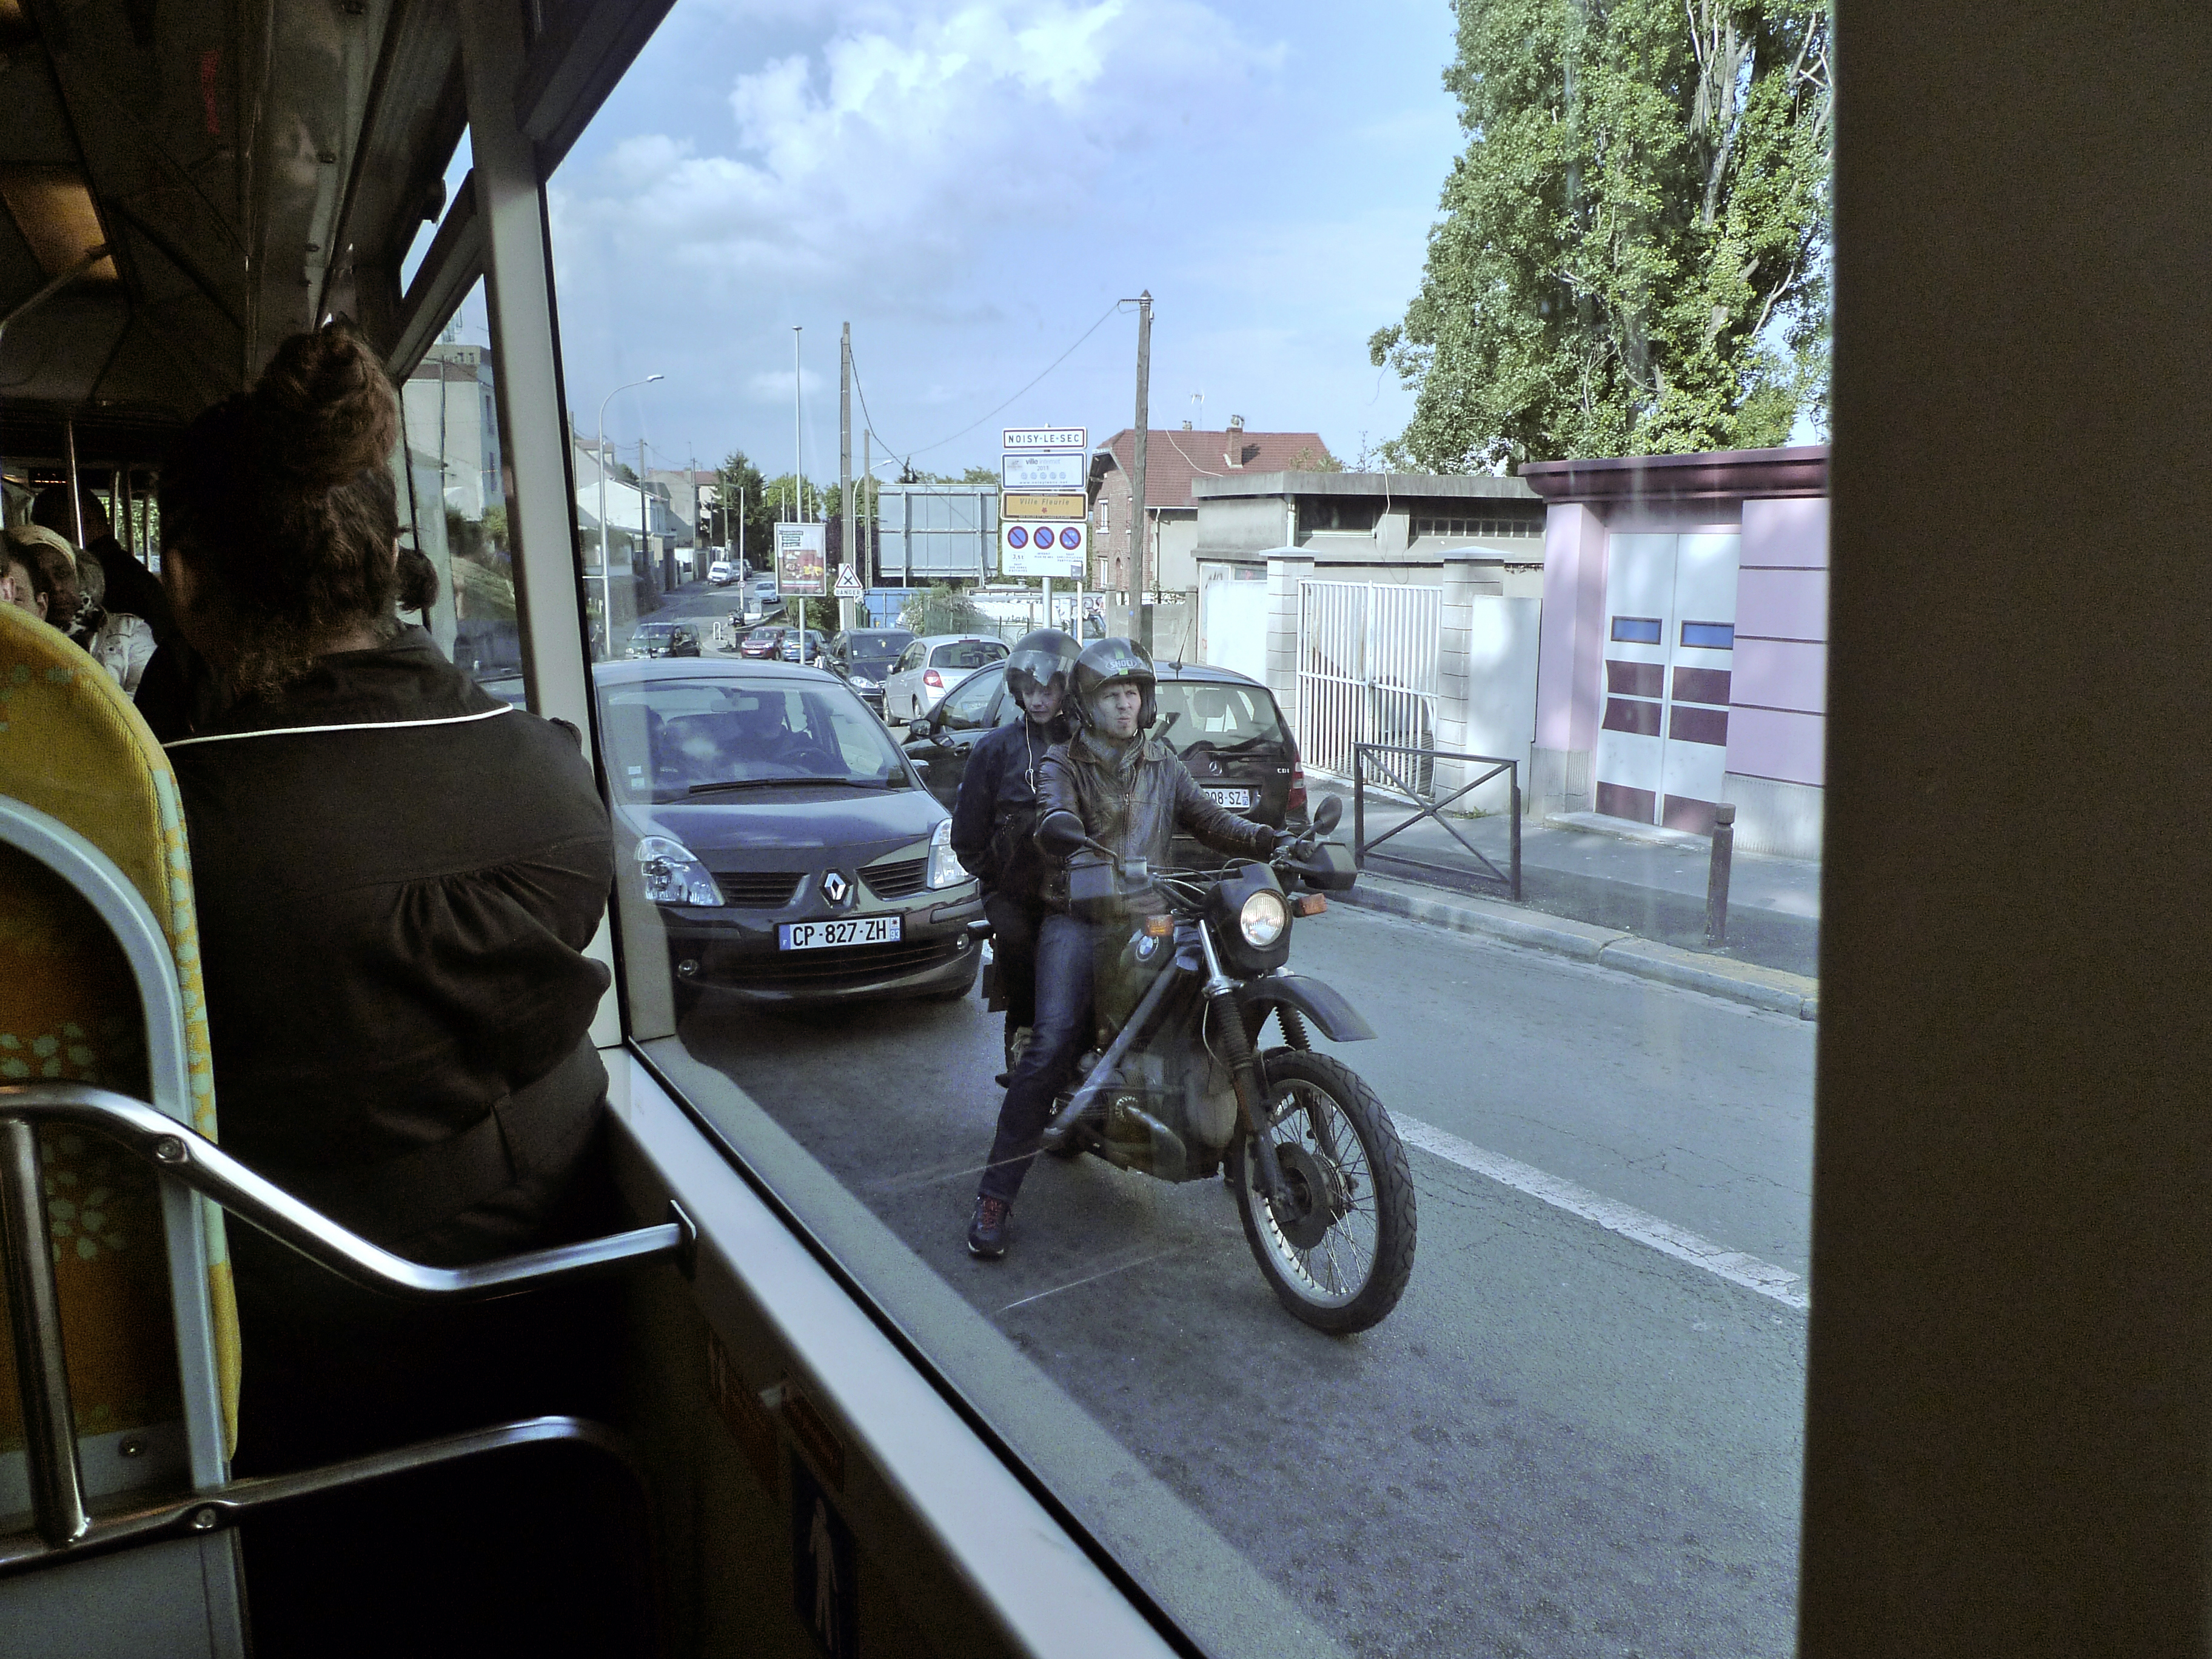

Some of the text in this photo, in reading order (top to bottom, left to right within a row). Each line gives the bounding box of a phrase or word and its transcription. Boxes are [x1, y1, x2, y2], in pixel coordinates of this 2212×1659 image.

[1008, 434, 1079, 443] NOISY-LE-SEC
[793, 920, 886, 947] CP-827-ZH
[890, 930, 900, 939] 93
